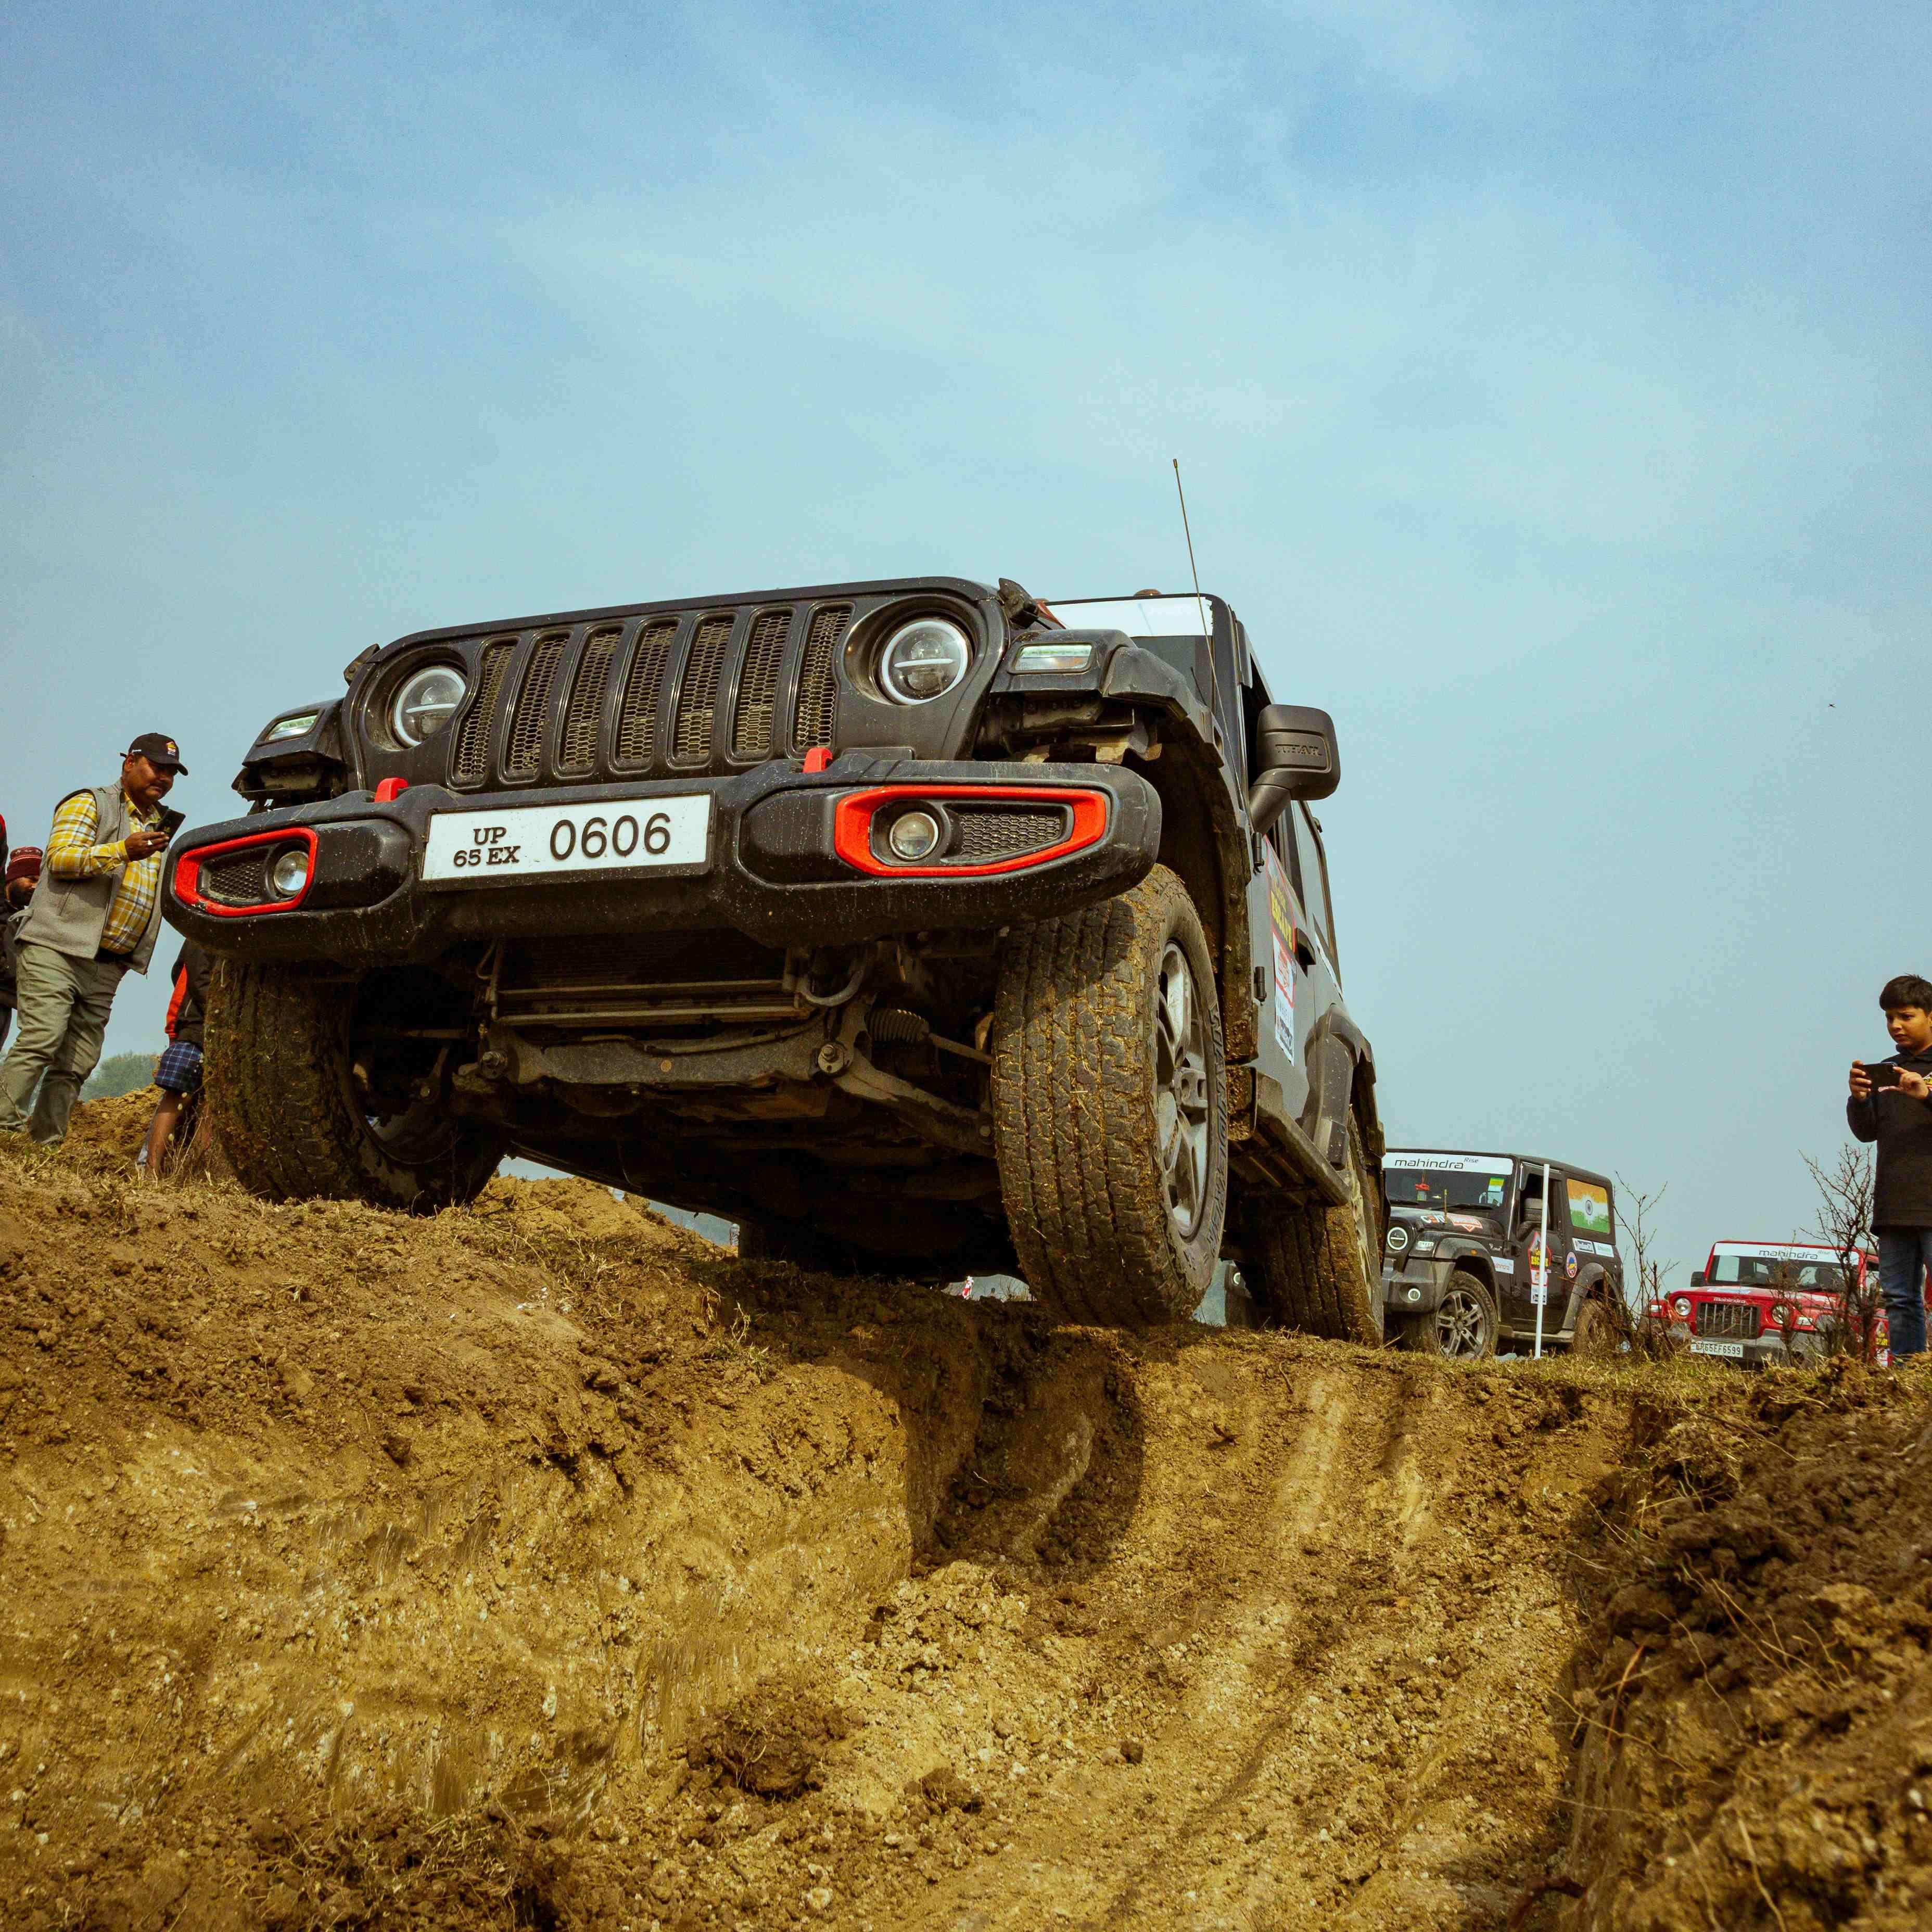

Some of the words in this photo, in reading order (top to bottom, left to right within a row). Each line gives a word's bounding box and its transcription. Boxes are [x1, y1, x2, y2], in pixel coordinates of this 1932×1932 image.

[473, 827, 507, 845] UP
[550, 812, 671, 860] 0606
[453, 849, 481, 867] 65
[486, 845, 521, 865] EX
[1394, 1159, 1464, 1169] mahindra
[1759, 1249, 1818, 1260] mahindra
